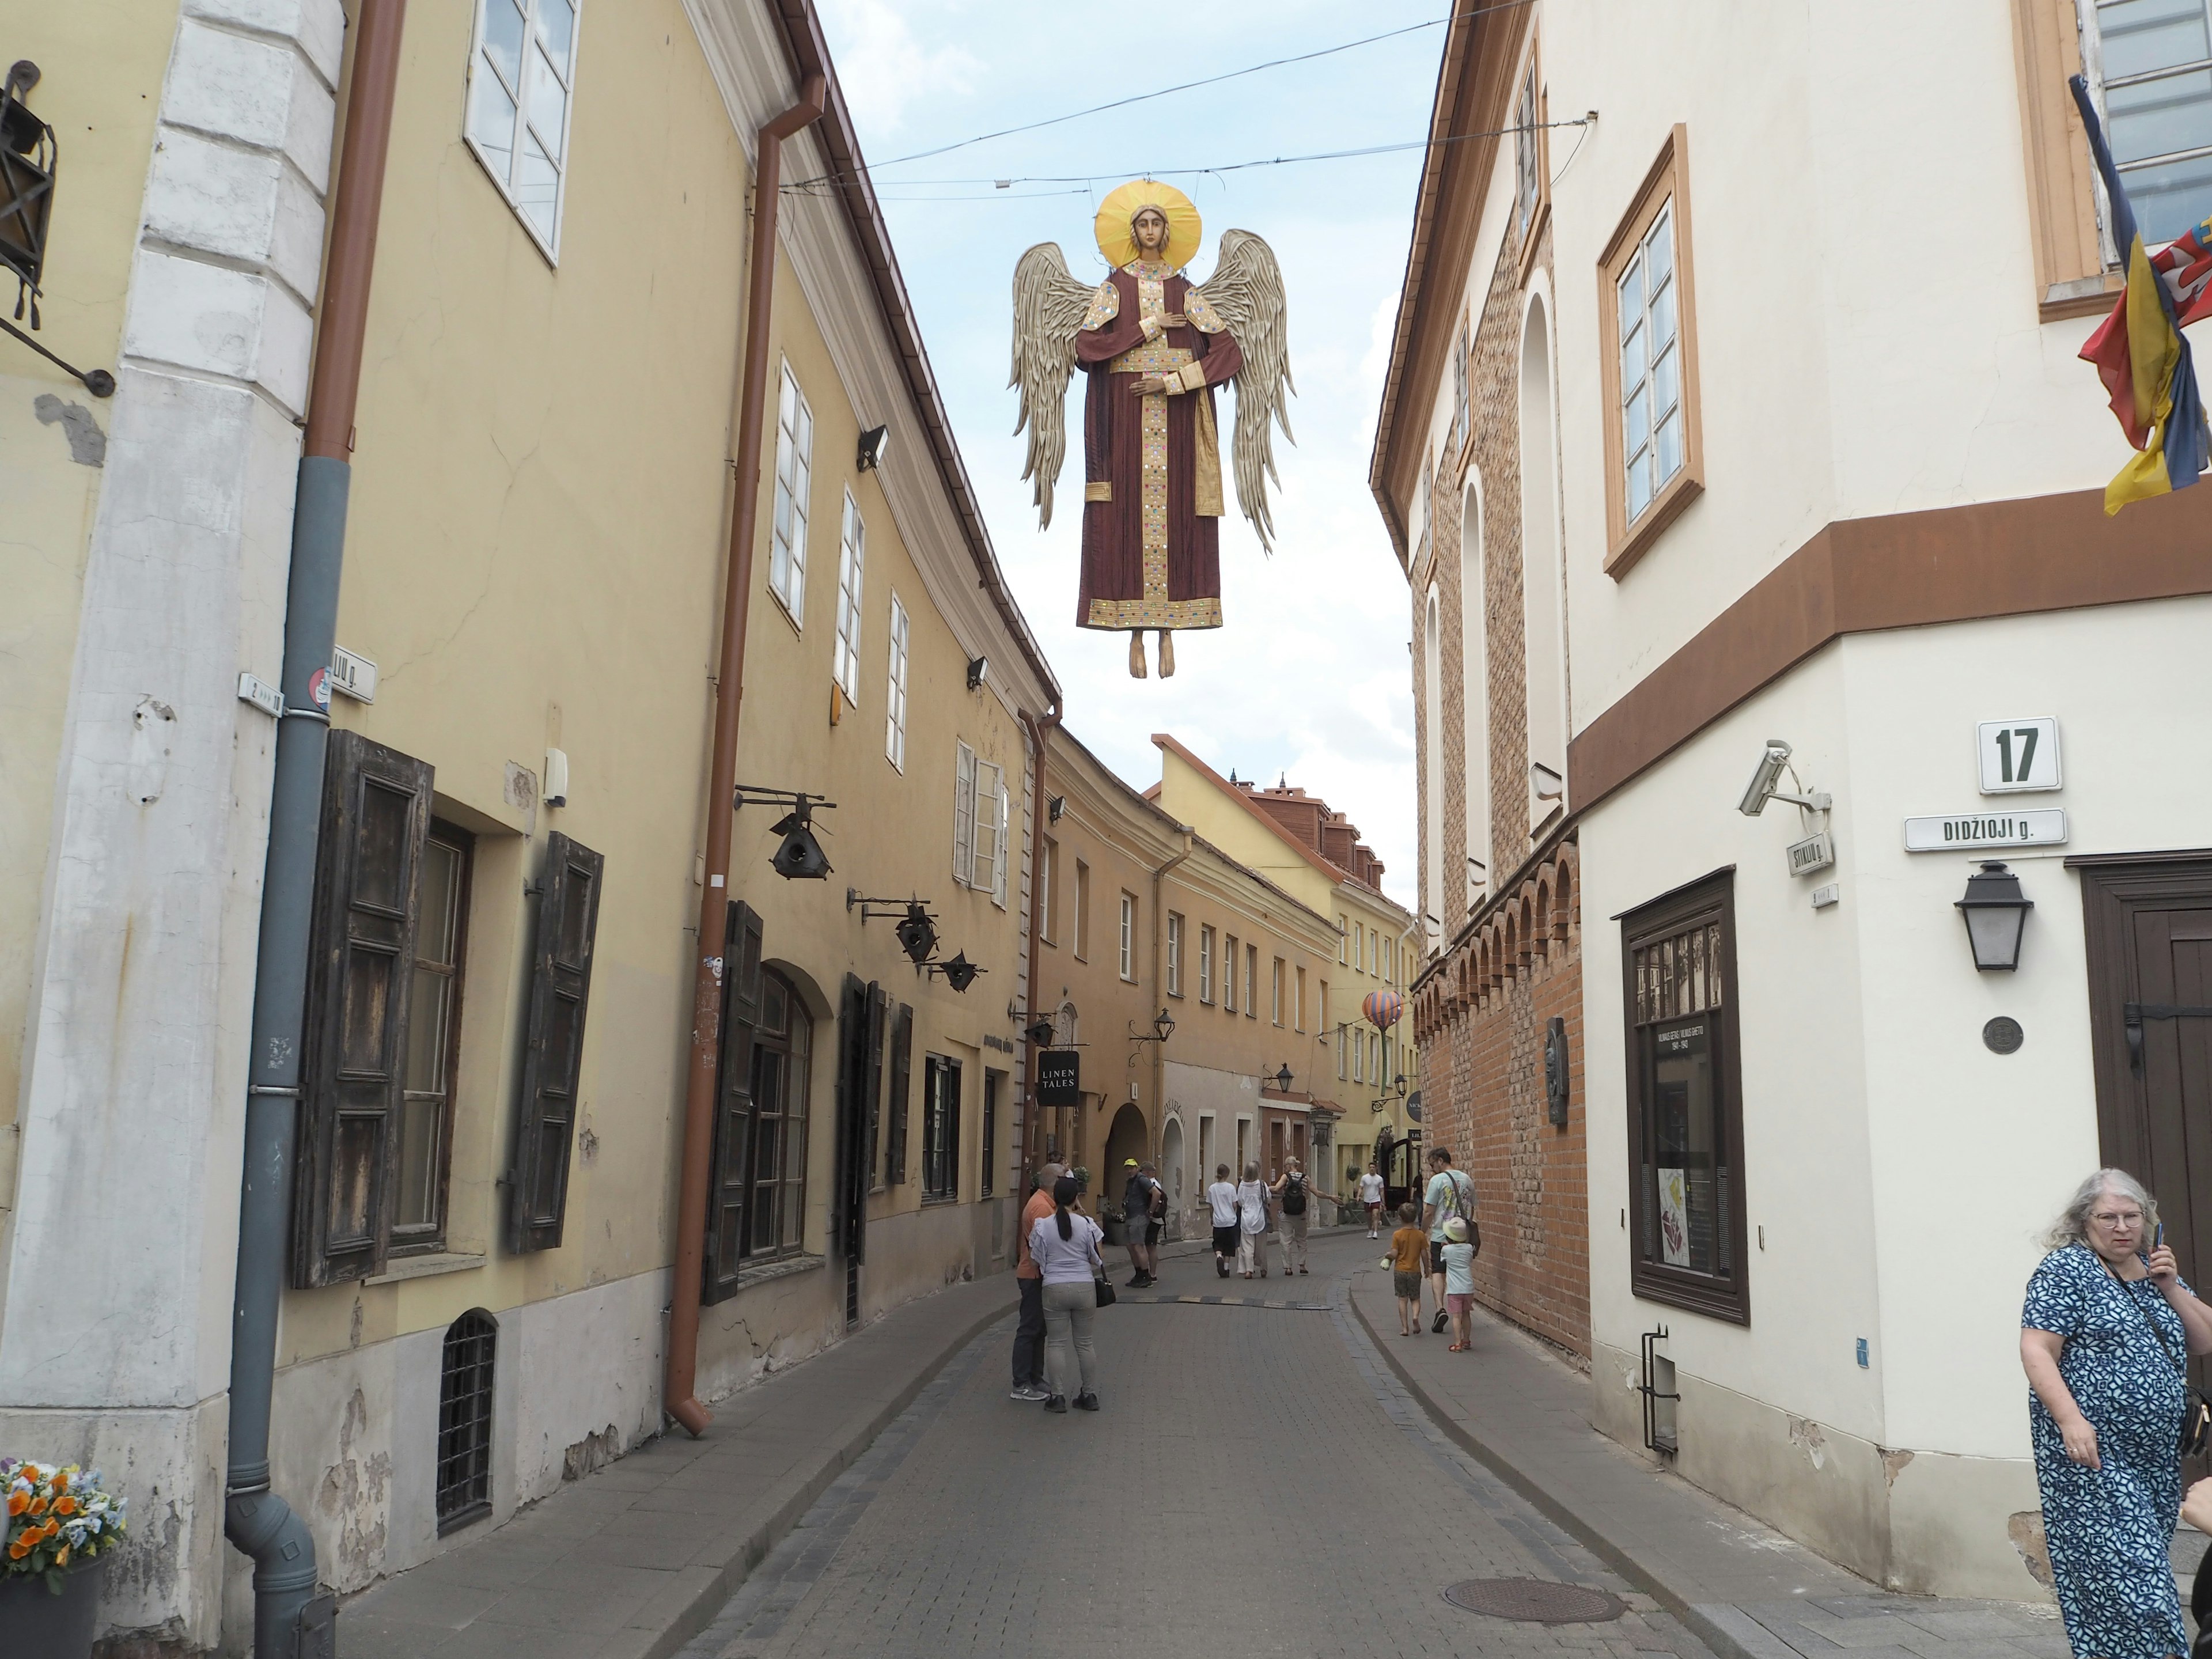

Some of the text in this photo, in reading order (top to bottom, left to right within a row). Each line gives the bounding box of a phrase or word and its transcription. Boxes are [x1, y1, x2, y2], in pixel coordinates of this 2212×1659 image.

[349, 666, 356, 688] g.
[252, 683, 280, 711] 2 10
[1996, 728, 2039, 783] 17
[1944, 817, 2034, 841] DIDŽIOJI g.
[1816, 844, 1823, 862] g.
[1043, 1069, 1074, 1079] LINEN
[1043, 1078, 1074, 1089] TALES
